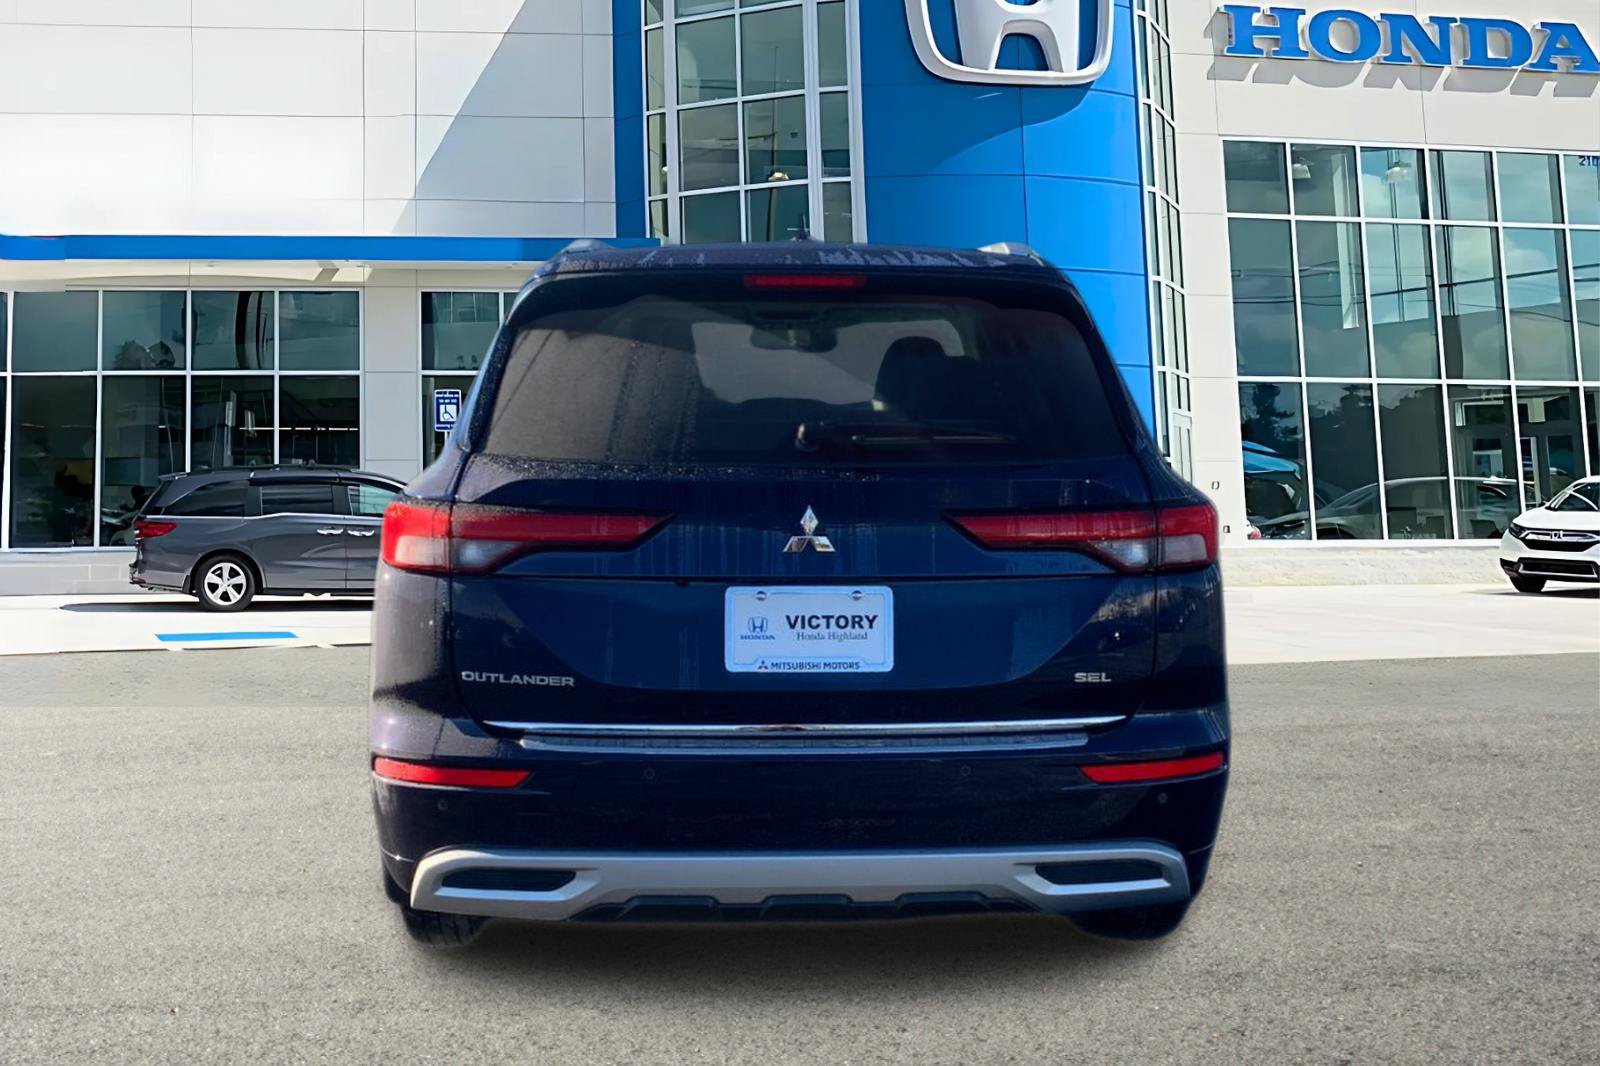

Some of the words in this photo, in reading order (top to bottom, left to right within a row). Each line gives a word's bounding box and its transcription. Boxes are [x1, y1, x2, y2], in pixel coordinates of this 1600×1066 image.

[1223, 4, 1600, 73] HONDA
[785, 615, 878, 630] VICTORY
[796, 631, 825, 641] Honda
[827, 631, 868, 643] Highland
[770, 661, 822, 671] MITSUBISHI
[823, 661, 860, 671] MOTORS
[461, 670, 575, 687] OUTLANDER
[1074, 672, 1111, 683] SEL
